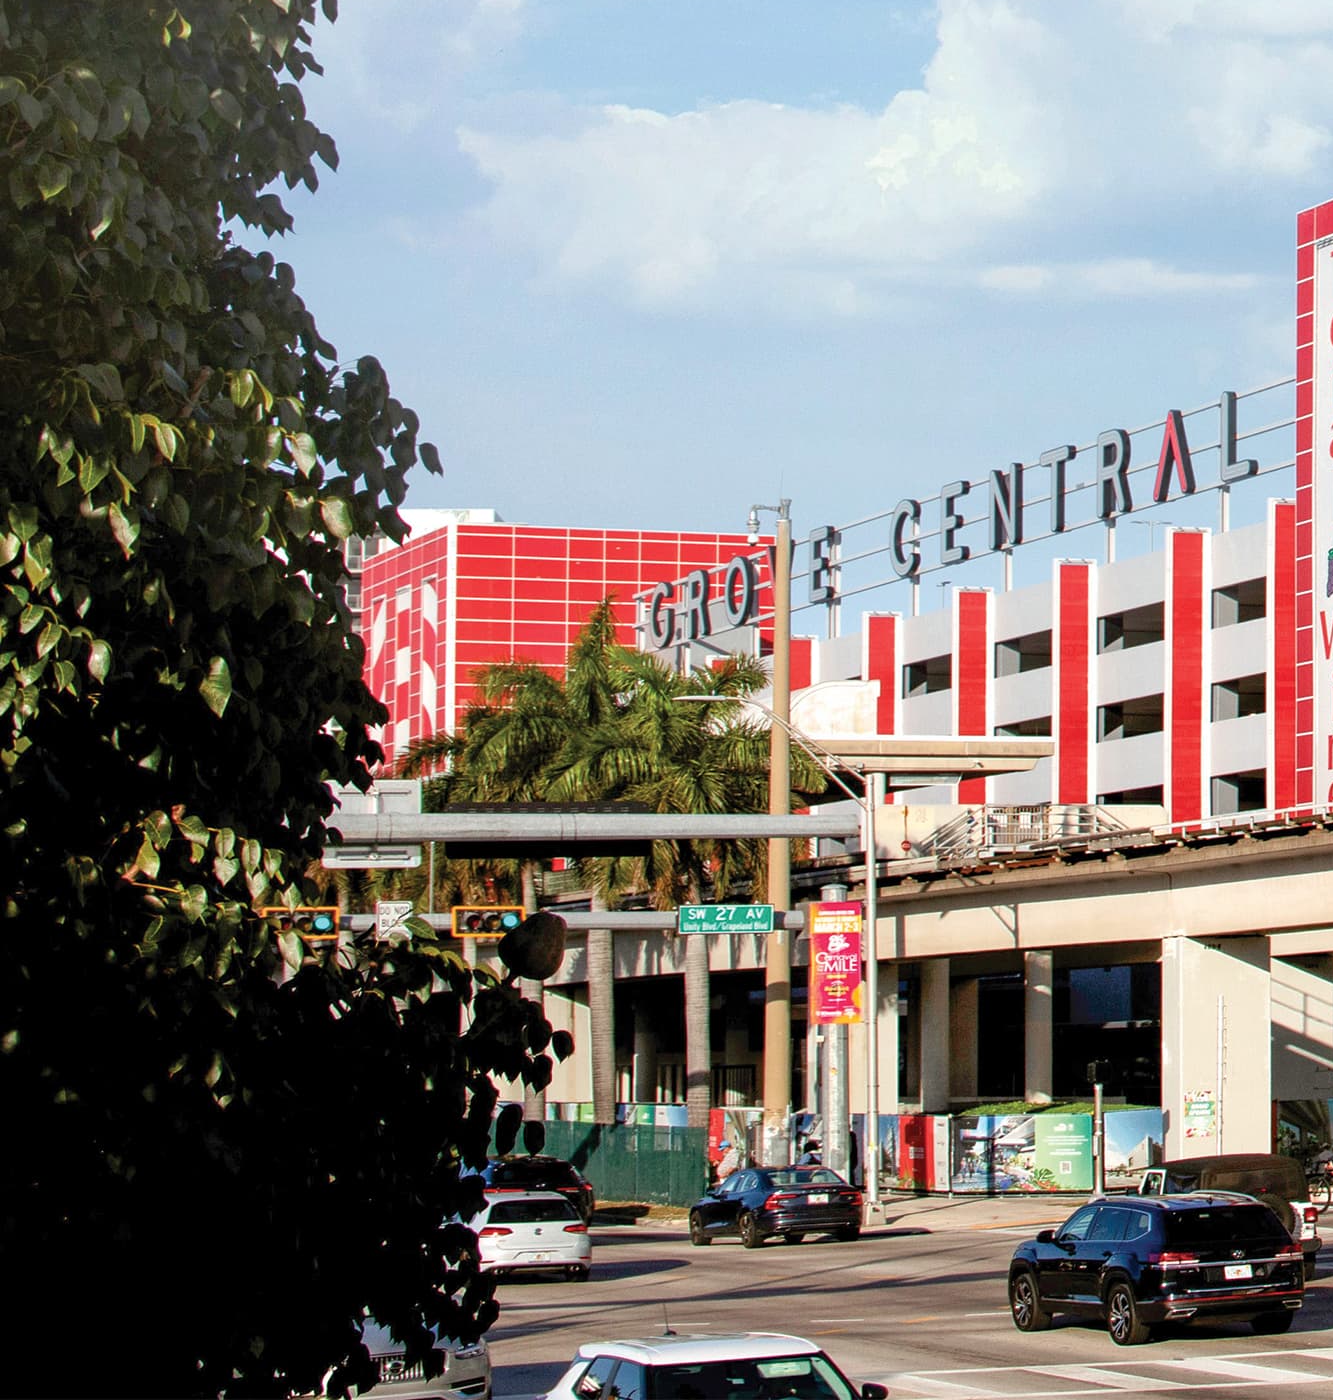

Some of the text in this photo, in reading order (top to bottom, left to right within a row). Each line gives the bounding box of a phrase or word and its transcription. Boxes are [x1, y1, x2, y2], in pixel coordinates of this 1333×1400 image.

[650, 391, 1260, 649] GROE CENTRAL
[379, 906, 391, 915] DO
[688, 906, 765, 921] SW 27 AV
[824, 959, 858, 972] MILE
